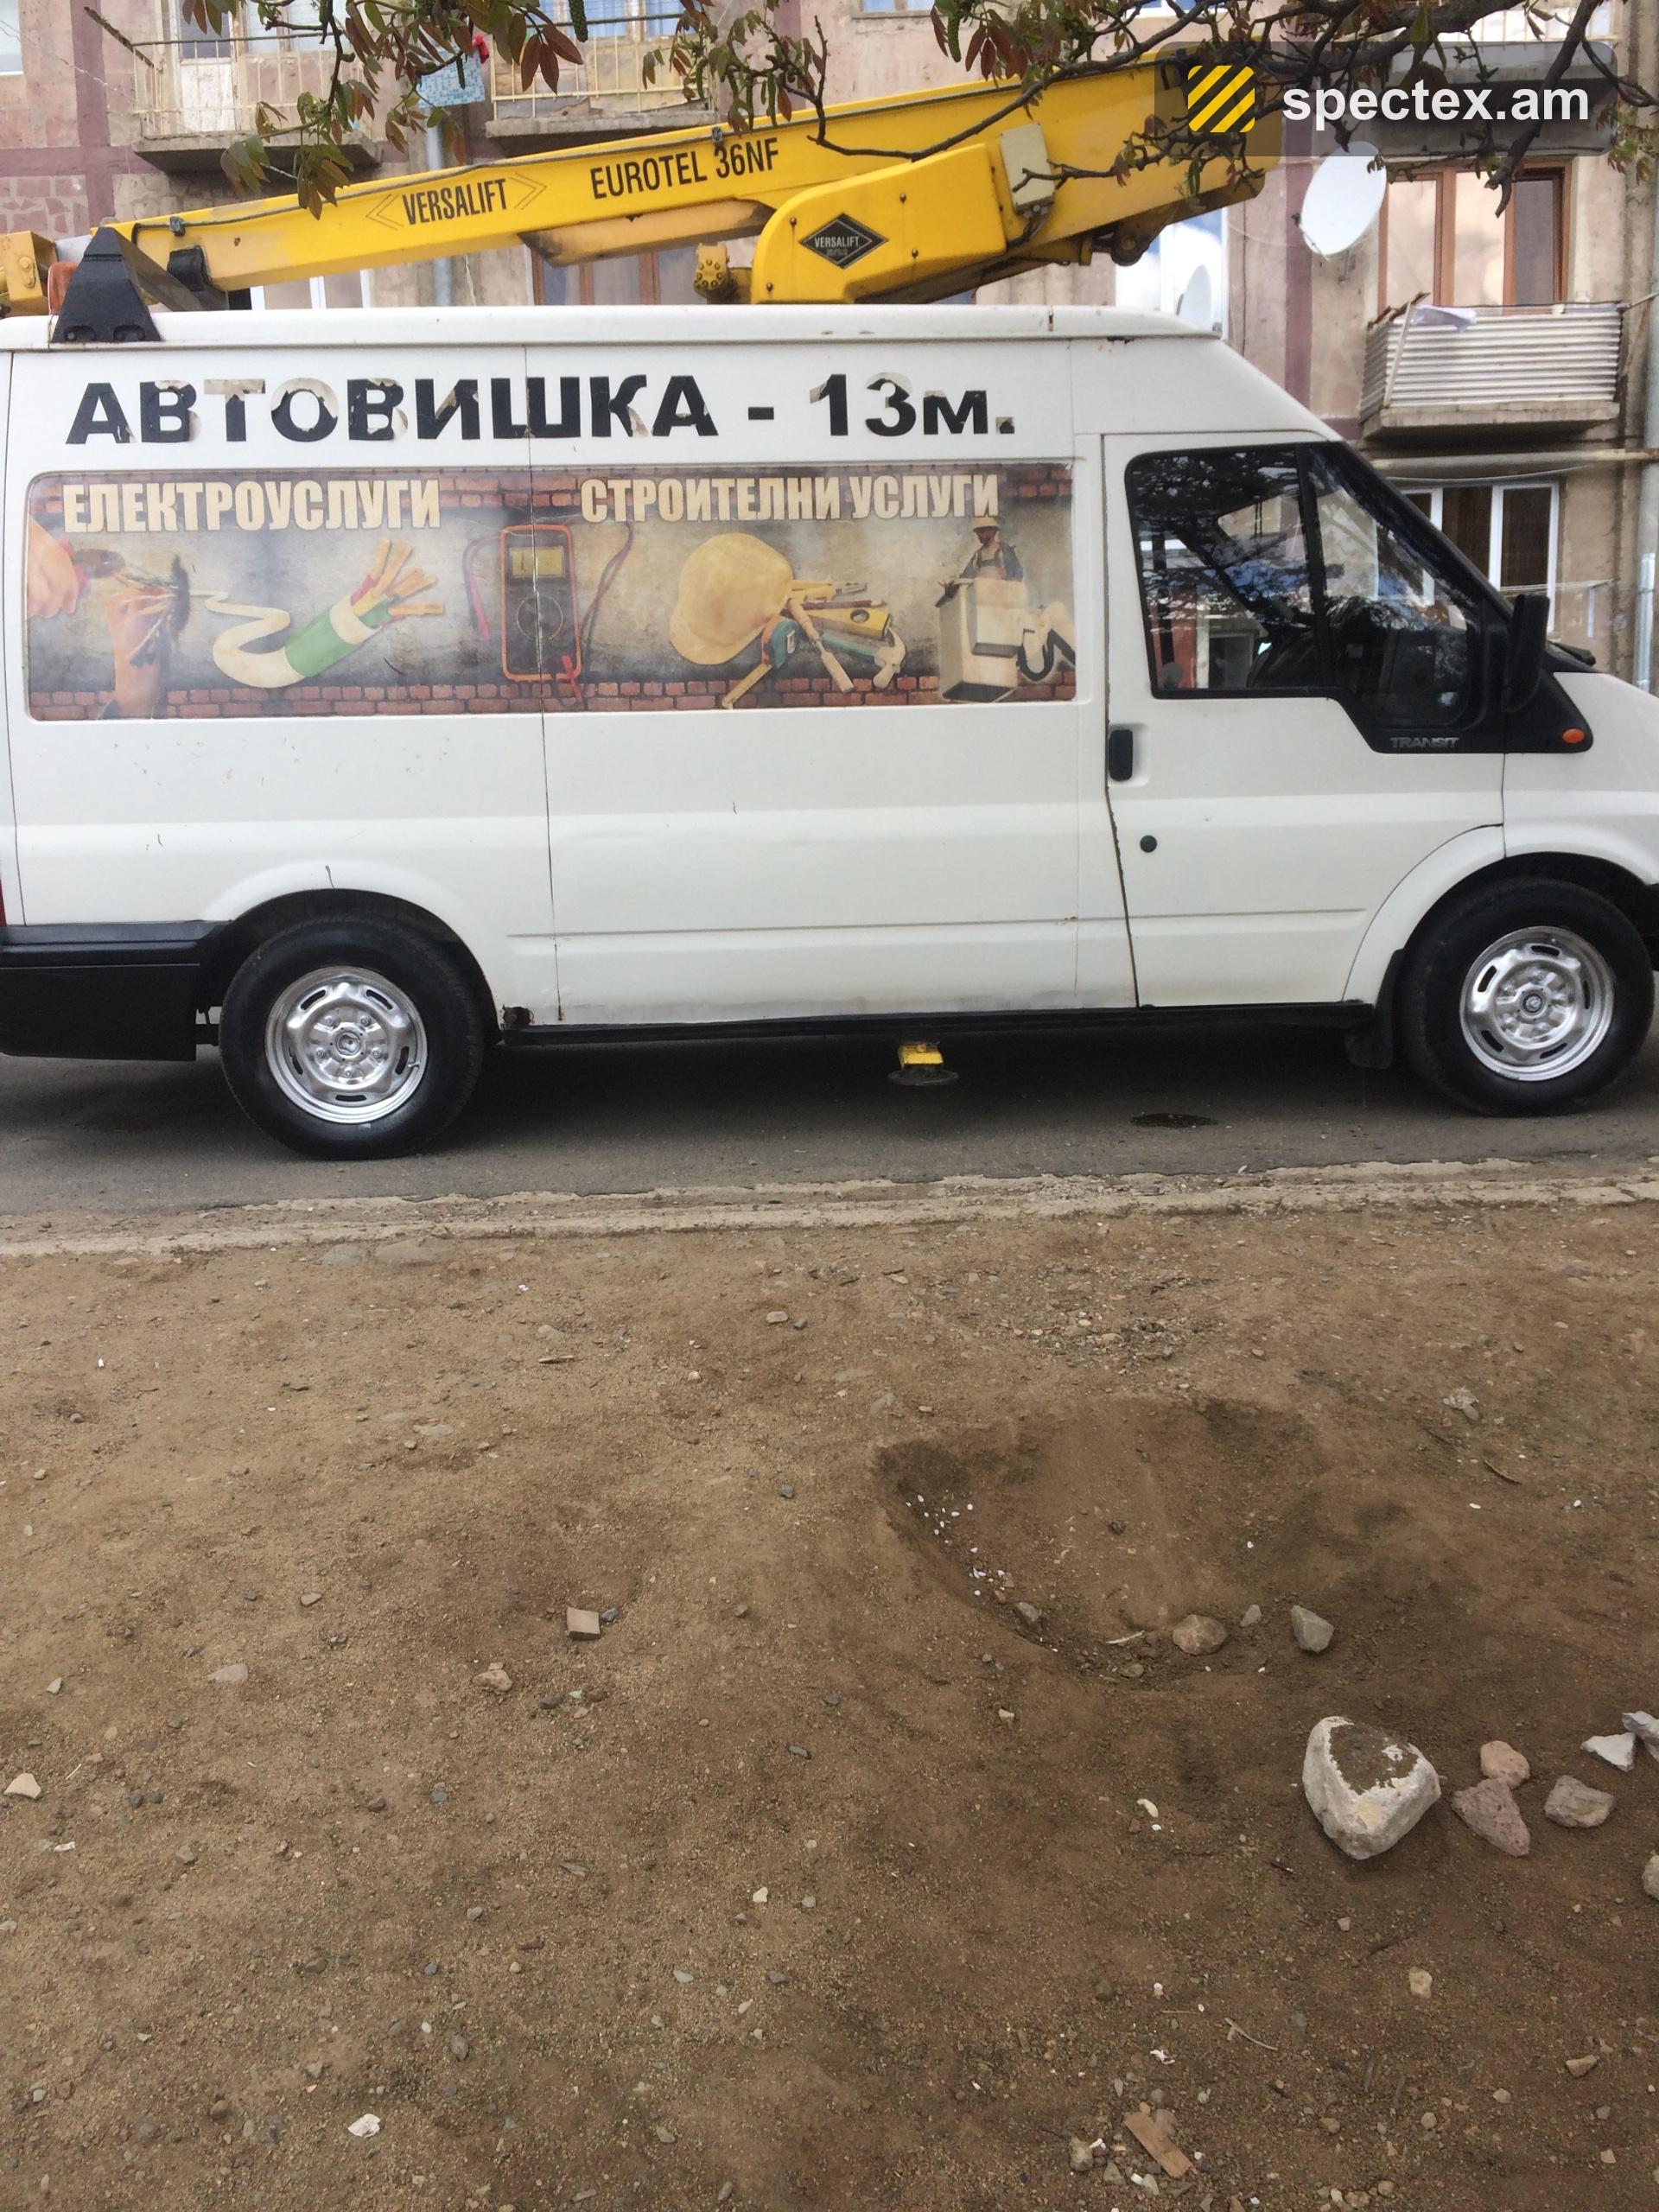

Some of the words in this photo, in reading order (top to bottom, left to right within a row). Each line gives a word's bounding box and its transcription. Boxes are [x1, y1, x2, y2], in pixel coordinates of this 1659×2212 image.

[590, 150, 708, 200] EUROTEL
[715, 137, 779, 178] 36NF
[402, 178, 508, 226] VERSALIFT
[814, 235, 860, 248] VERSALIFT
[66, 374, 720, 444] АВТОВИШКА
[62, 479, 442, 533] ЕЛЕКТРОУСЛУГИ
[581, 475, 843, 523] СТРОИТЕЛНИ
[849, 474, 1000, 519] УСЛУГИ
[1389, 737, 1460, 748] TRANSIT
